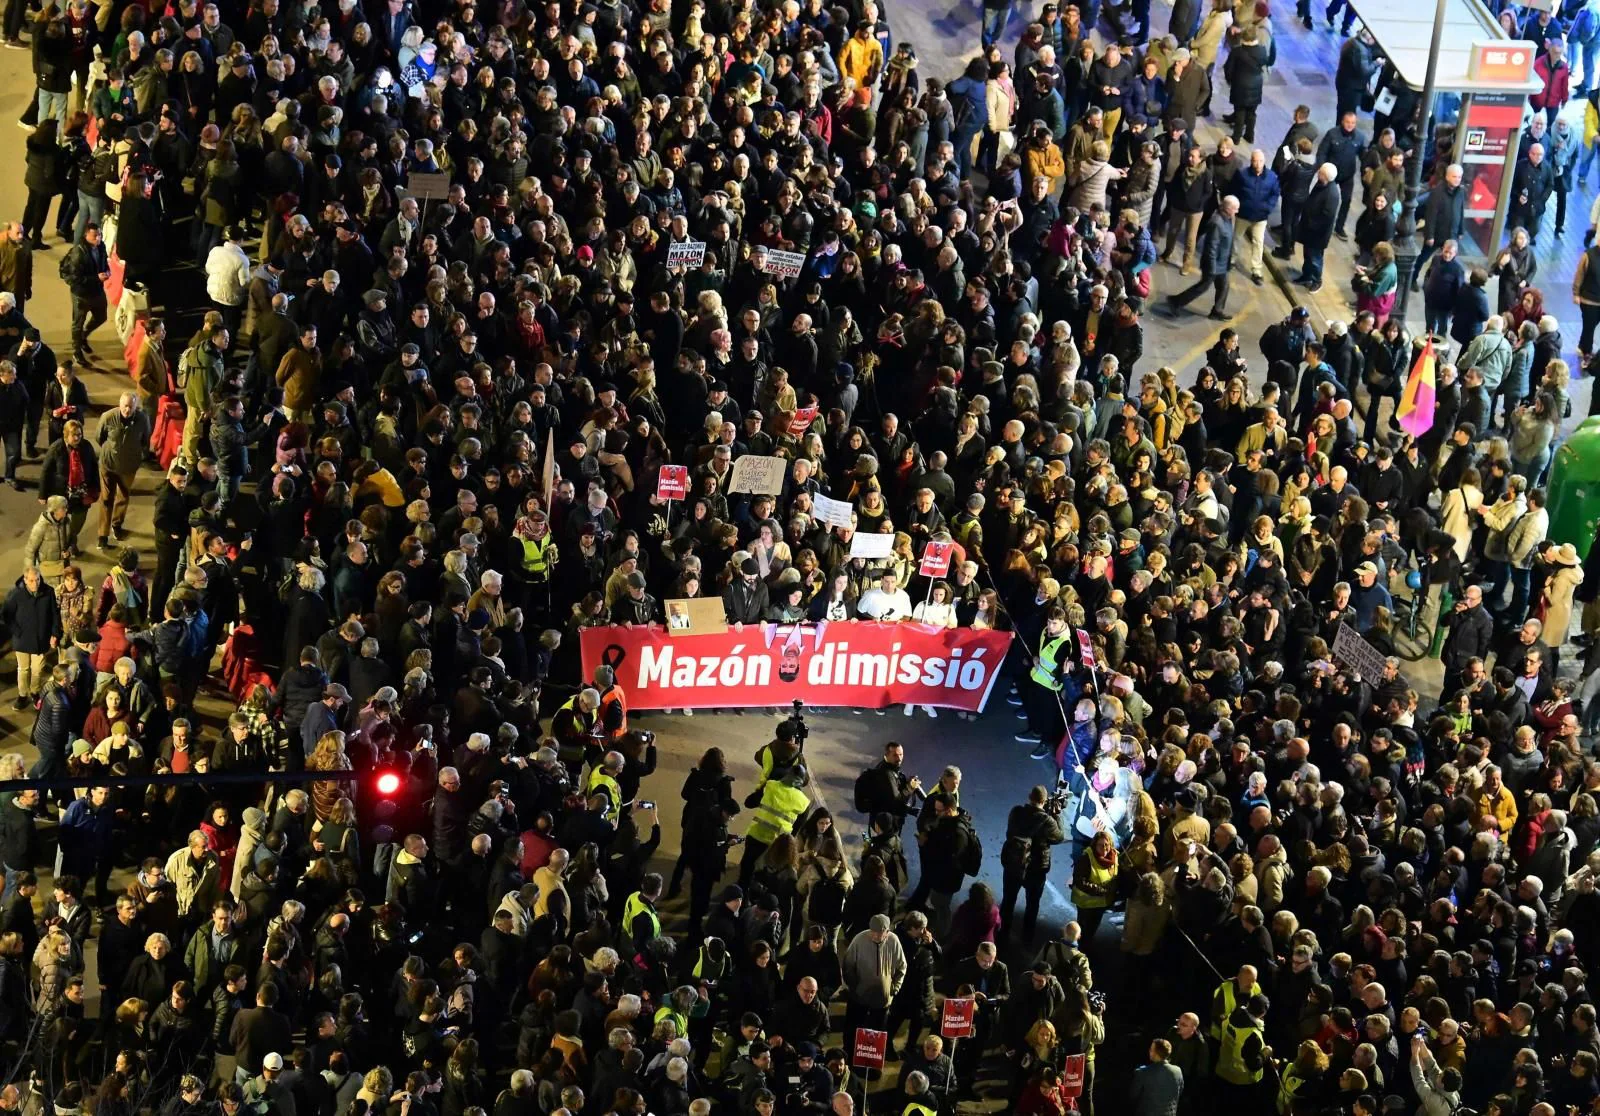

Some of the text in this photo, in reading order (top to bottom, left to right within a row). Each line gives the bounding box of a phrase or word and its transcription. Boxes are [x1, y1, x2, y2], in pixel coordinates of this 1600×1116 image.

[637, 641, 987, 690] Mazón dimissió
[857, 1044, 876, 1052] Mazón
[856, 1051, 882, 1060] dimissió
